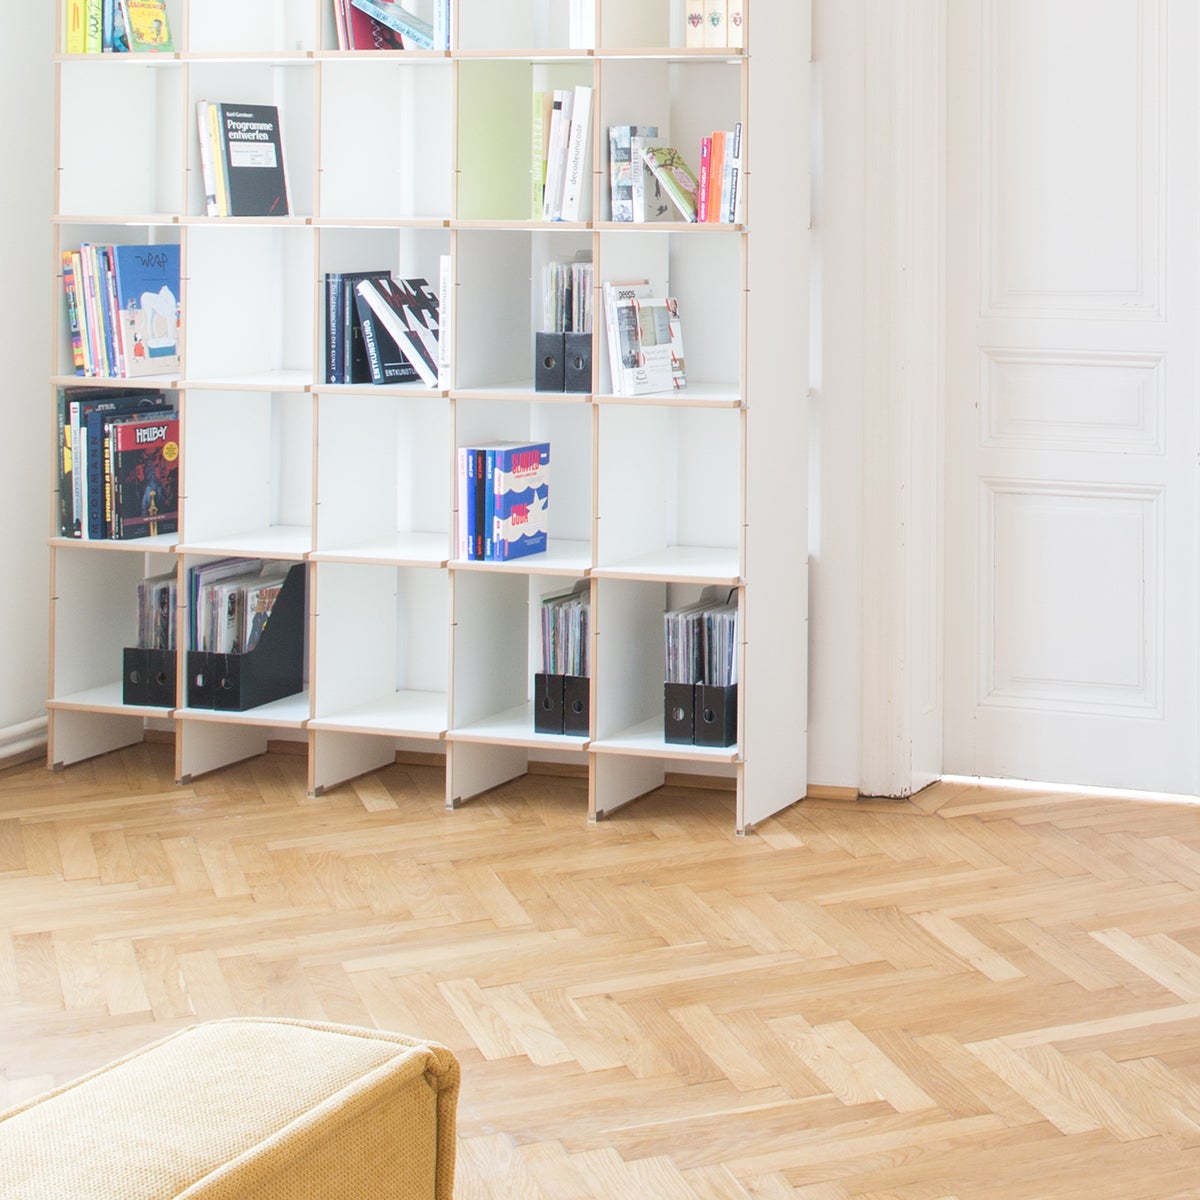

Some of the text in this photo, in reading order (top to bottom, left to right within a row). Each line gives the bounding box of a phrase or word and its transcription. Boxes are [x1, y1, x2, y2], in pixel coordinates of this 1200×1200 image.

[227, 119, 273, 131] Programme
[228, 130, 269, 141] entwerfen
[571, 124, 582, 184] decodeunicode
[363, 320, 381, 379] ENTKUNSTUNG
[136, 425, 168, 443] HELLBOY
